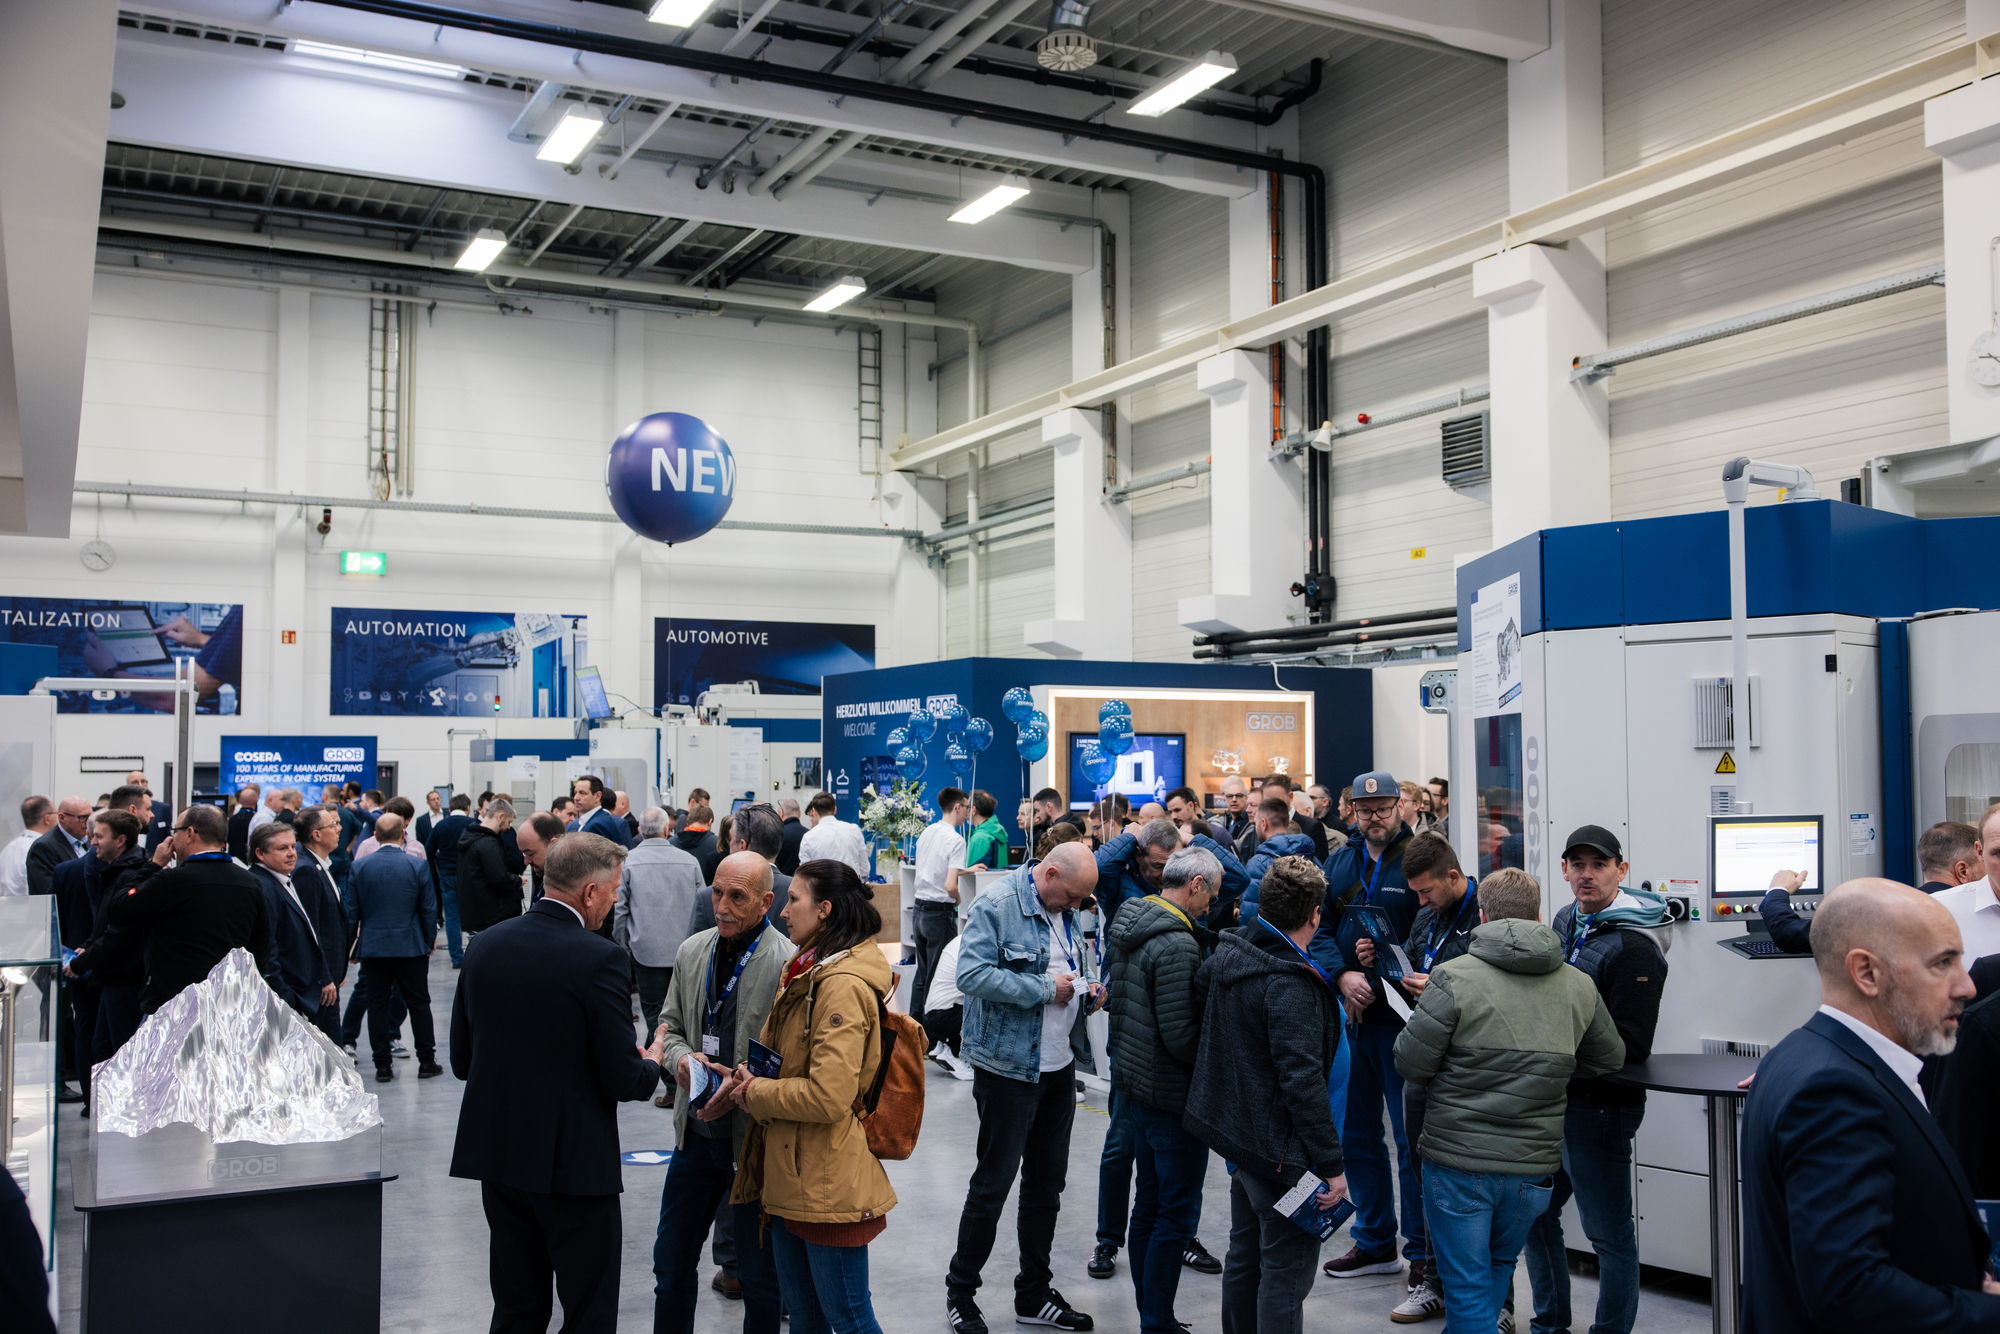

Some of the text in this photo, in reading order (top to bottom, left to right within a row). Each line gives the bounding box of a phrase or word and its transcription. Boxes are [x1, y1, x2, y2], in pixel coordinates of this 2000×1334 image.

[1, 609, 120, 629] TALIZATION
[344, 620, 466, 638] AUTOMATION
[665, 629, 769, 646] AUTOMOTIVE
[836, 697, 920, 719] HERZLICH WILLKOMMEN
[843, 721, 877, 738] WELCOME
[1248, 714, 1296, 731] GROB
[234, 751, 283, 763] COSERA
[325, 749, 363, 760] GROB
[236, 764, 363, 773] 100 YEARS OF MANUFACTURING
[234, 773, 346, 783] EXPERIENCE IN ONE SYSTEM
[211, 1156, 278, 1180] GROB
